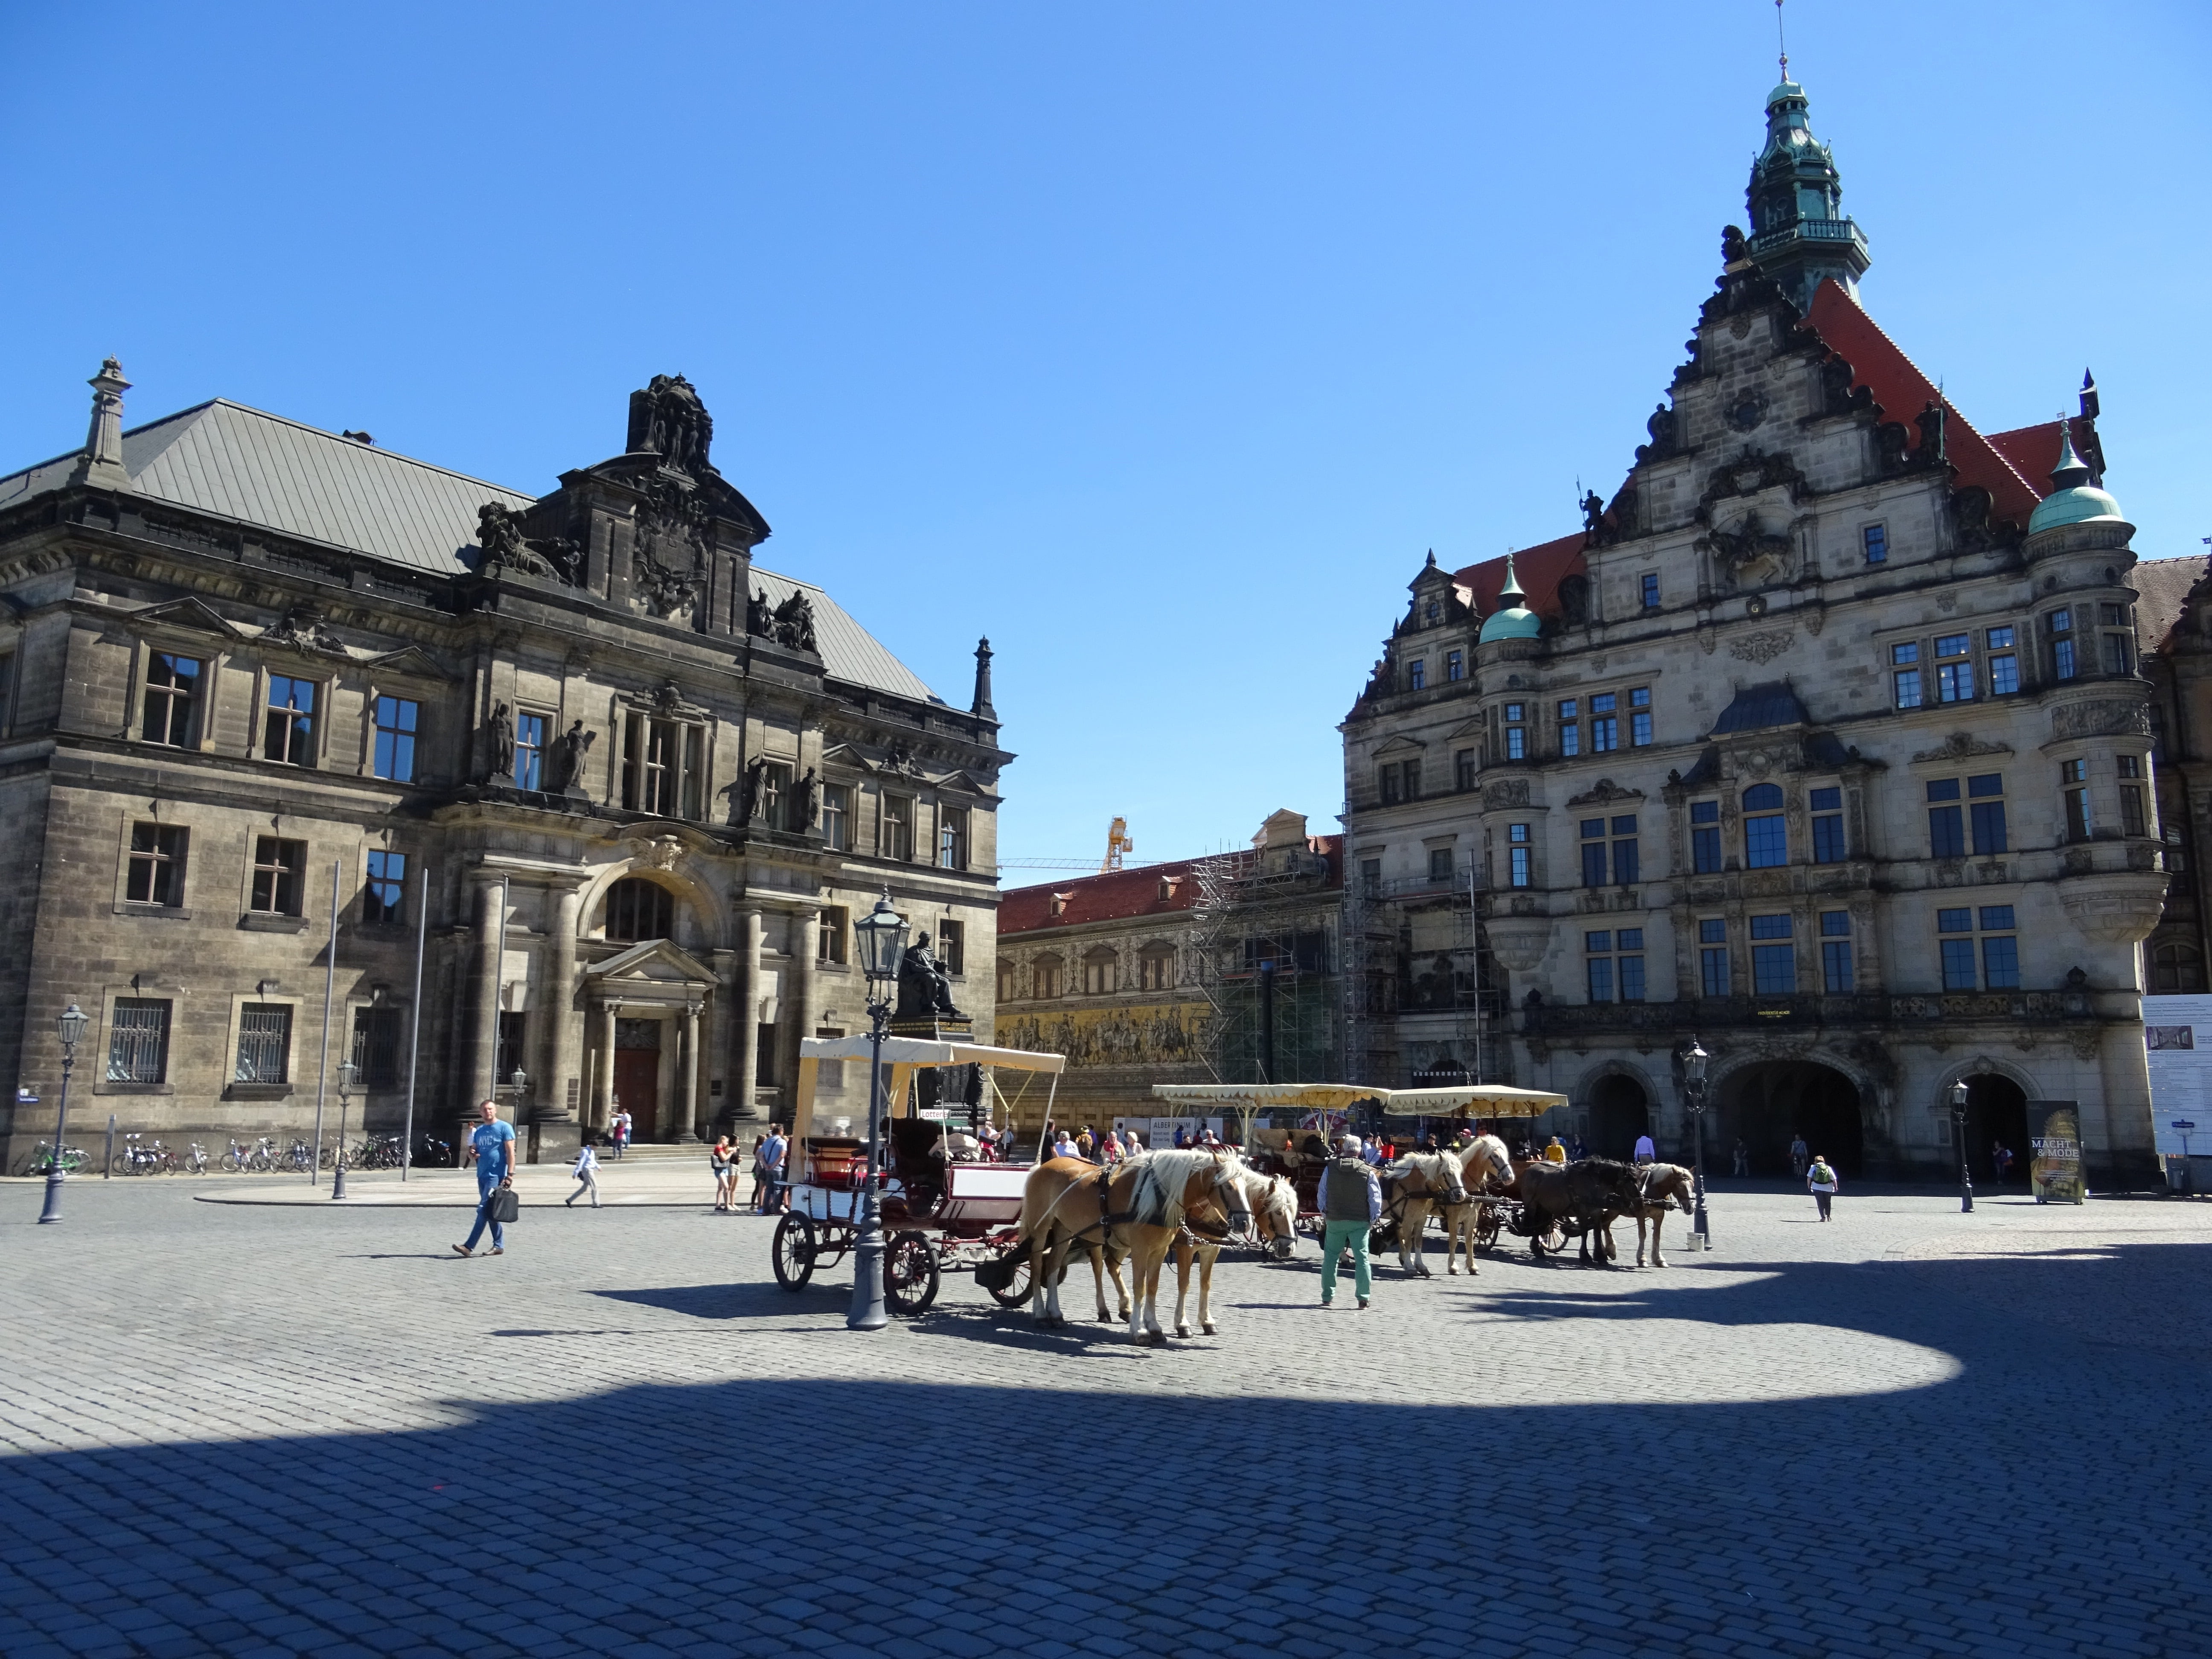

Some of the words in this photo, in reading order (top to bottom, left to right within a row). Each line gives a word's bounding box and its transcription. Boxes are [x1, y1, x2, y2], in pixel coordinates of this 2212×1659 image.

[1752, 604, 1758, 612] G
[2031, 1140, 2071, 1148] MACHT
[2047, 1149, 2079, 1157] MODE
